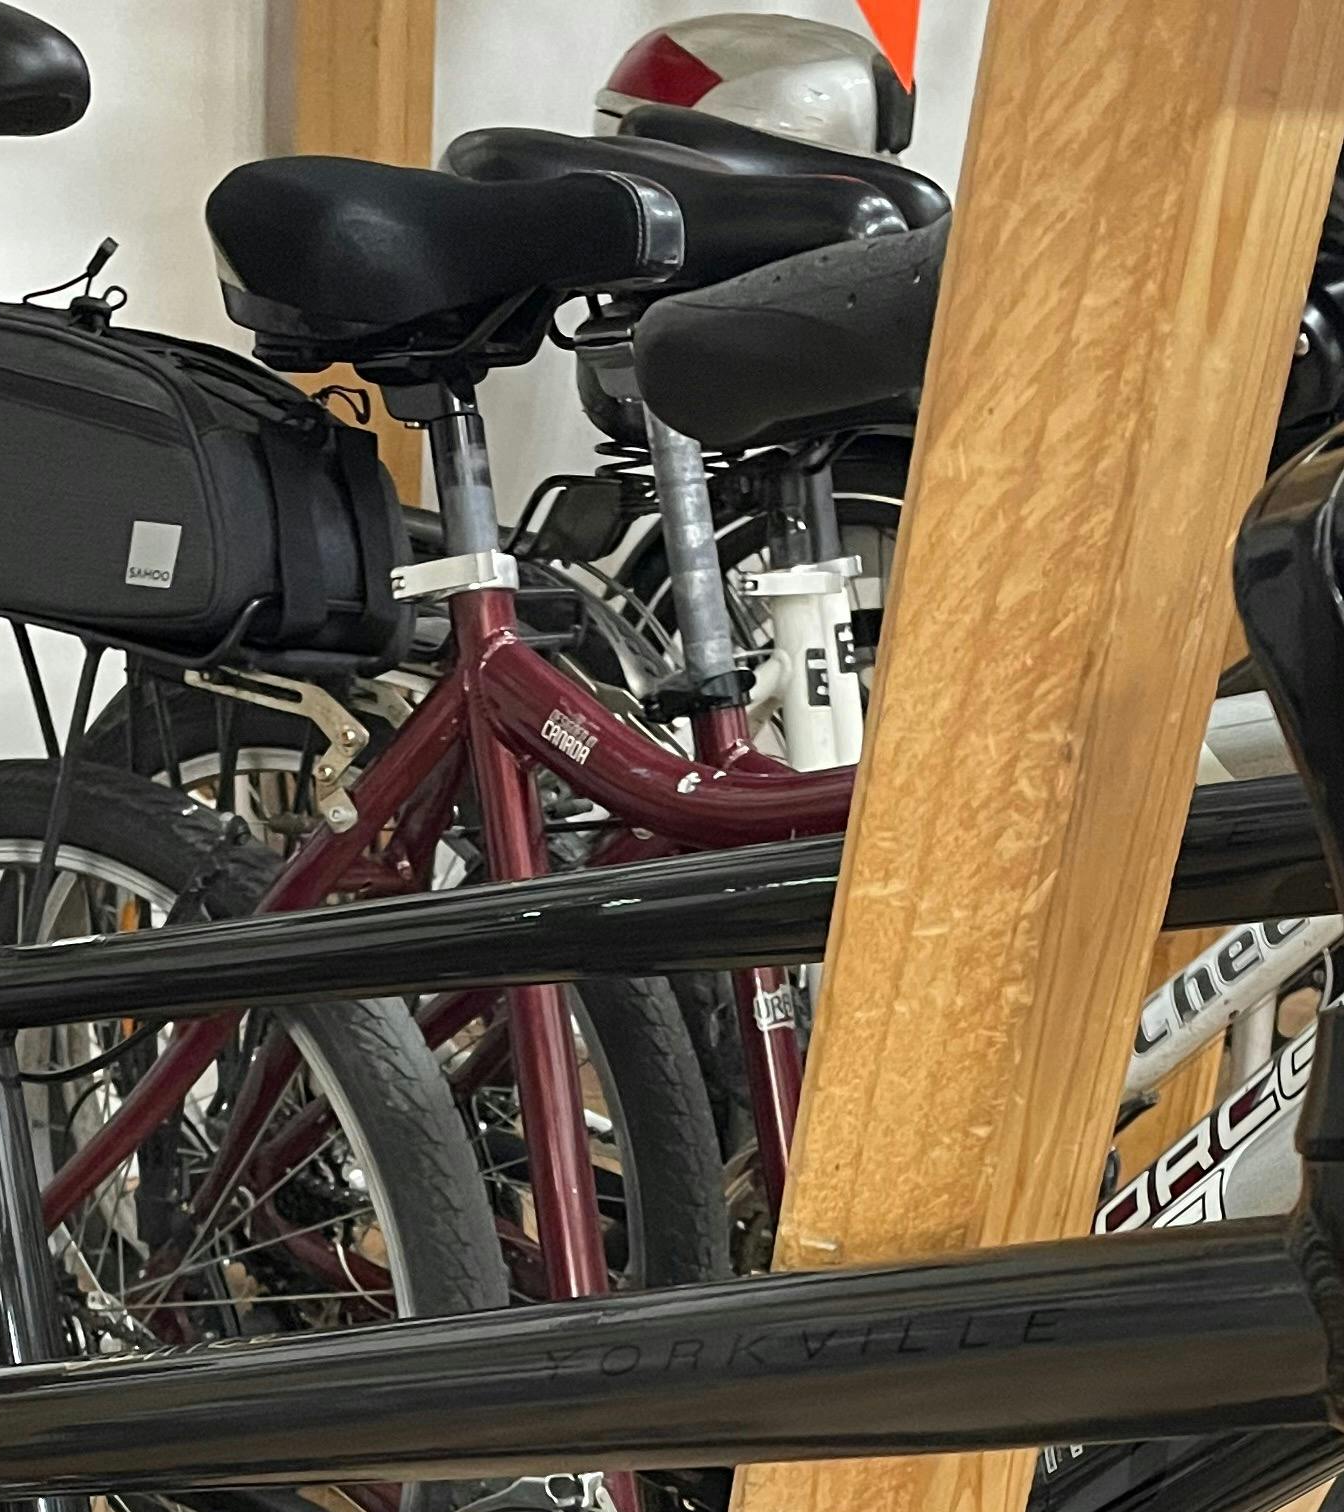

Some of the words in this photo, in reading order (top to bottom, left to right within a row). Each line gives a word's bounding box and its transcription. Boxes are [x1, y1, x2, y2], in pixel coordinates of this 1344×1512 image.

[129, 566, 170, 582] SAHOO
[541, 719, 591, 765] CANADA
[544, 1306, 1067, 1381] YORKVILLE
